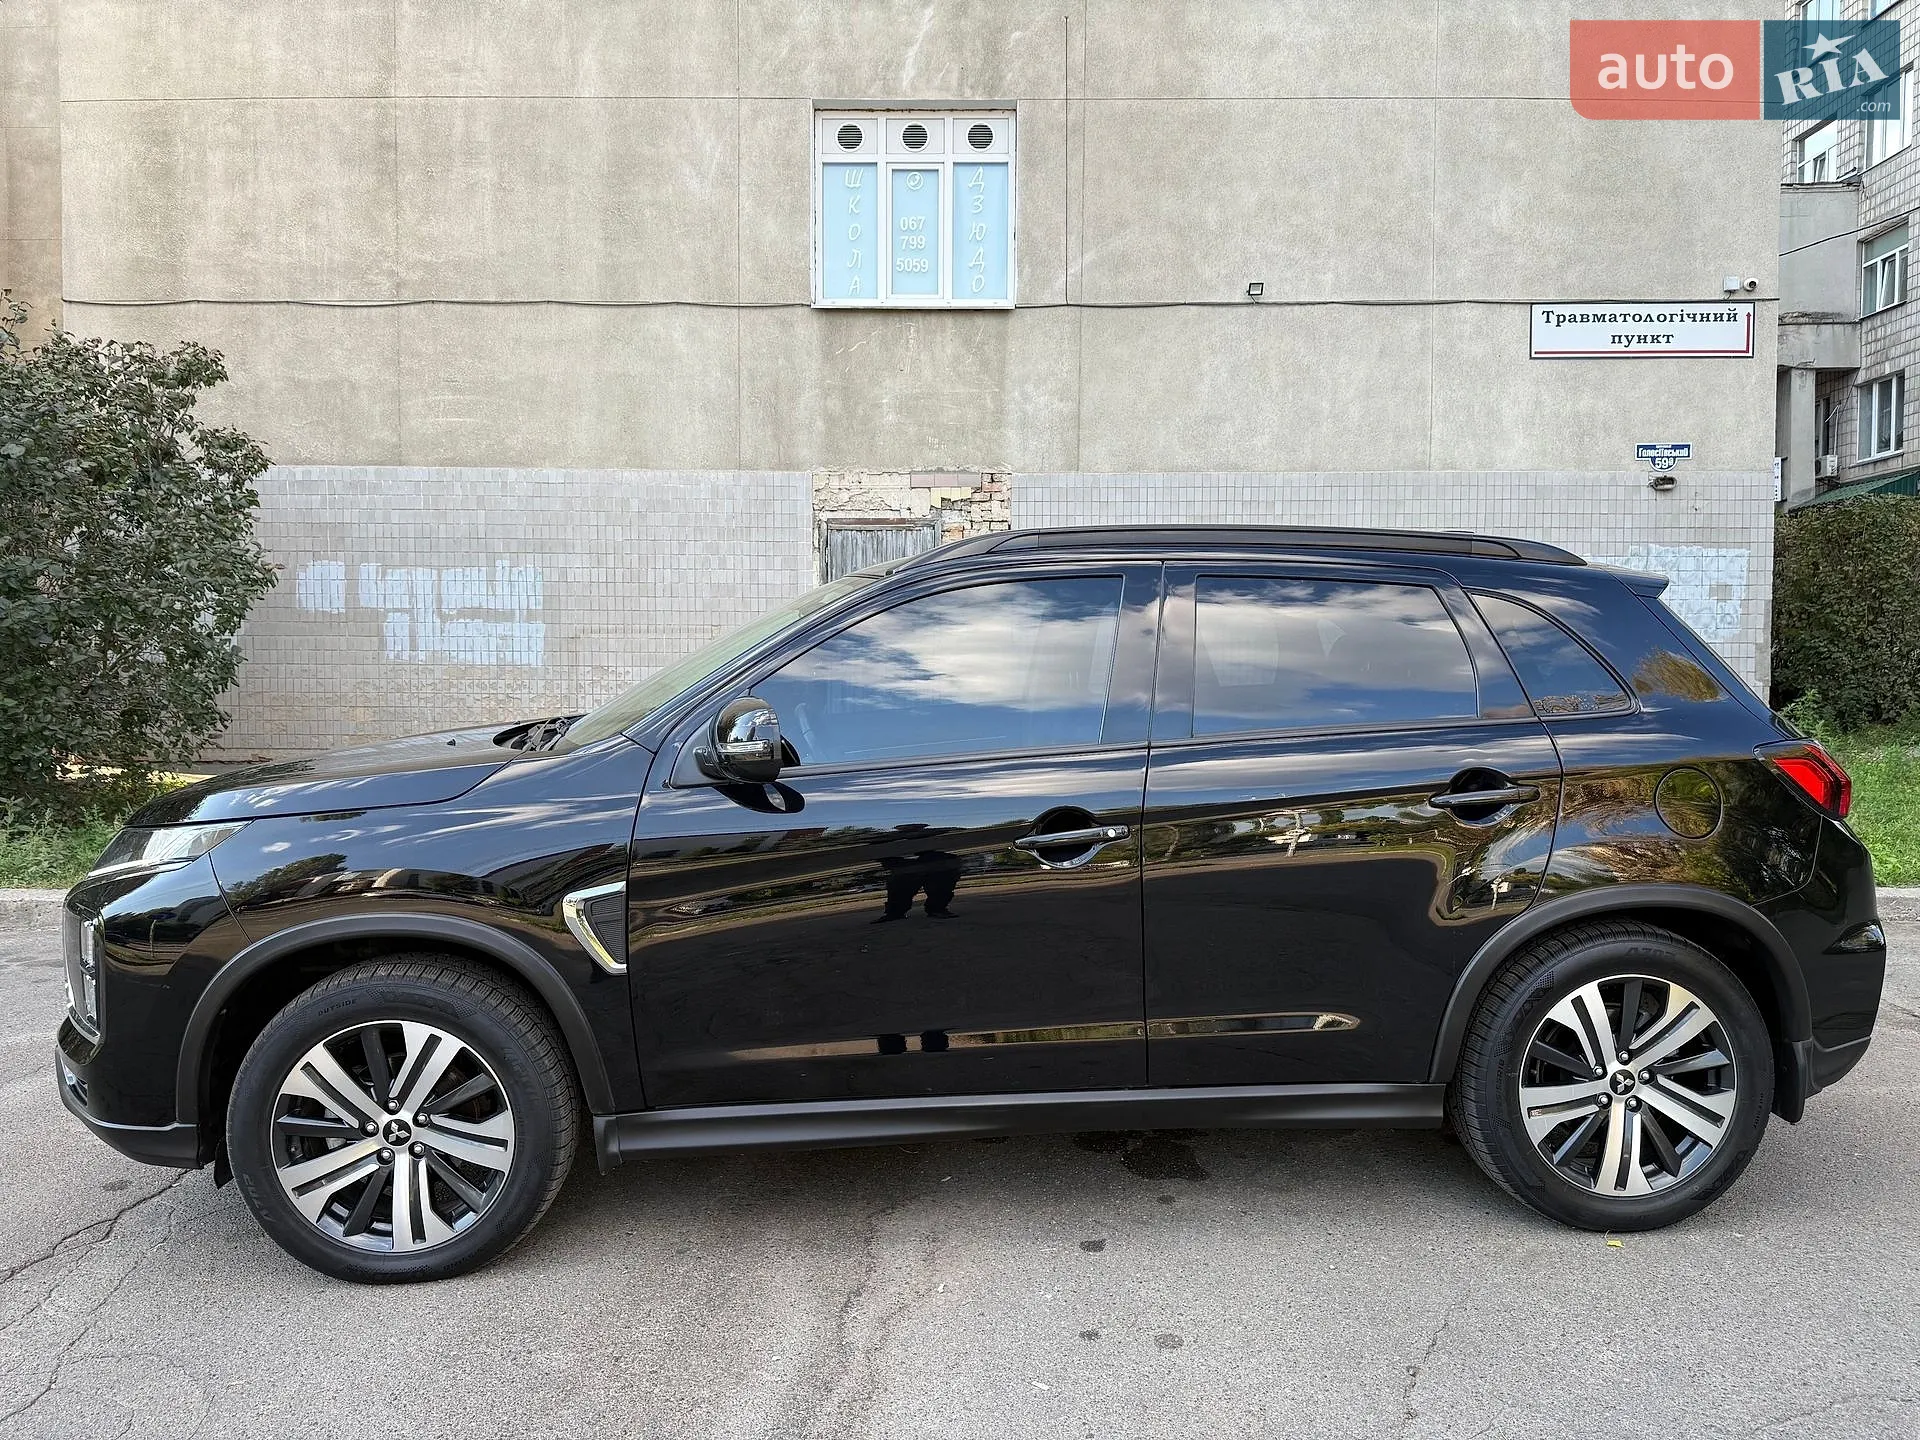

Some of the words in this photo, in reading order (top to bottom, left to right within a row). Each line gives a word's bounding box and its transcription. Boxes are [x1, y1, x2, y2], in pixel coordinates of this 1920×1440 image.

[844, 167, 865, 295] ШКОЛА
[900, 215, 926, 231] 067
[967, 165, 987, 294] ДЗЮДО
[900, 235, 926, 250] 799
[896, 257, 929, 273] 5059
[1541, 308, 1739, 328] Травматологічний
[1610, 333, 1675, 348] пункт
